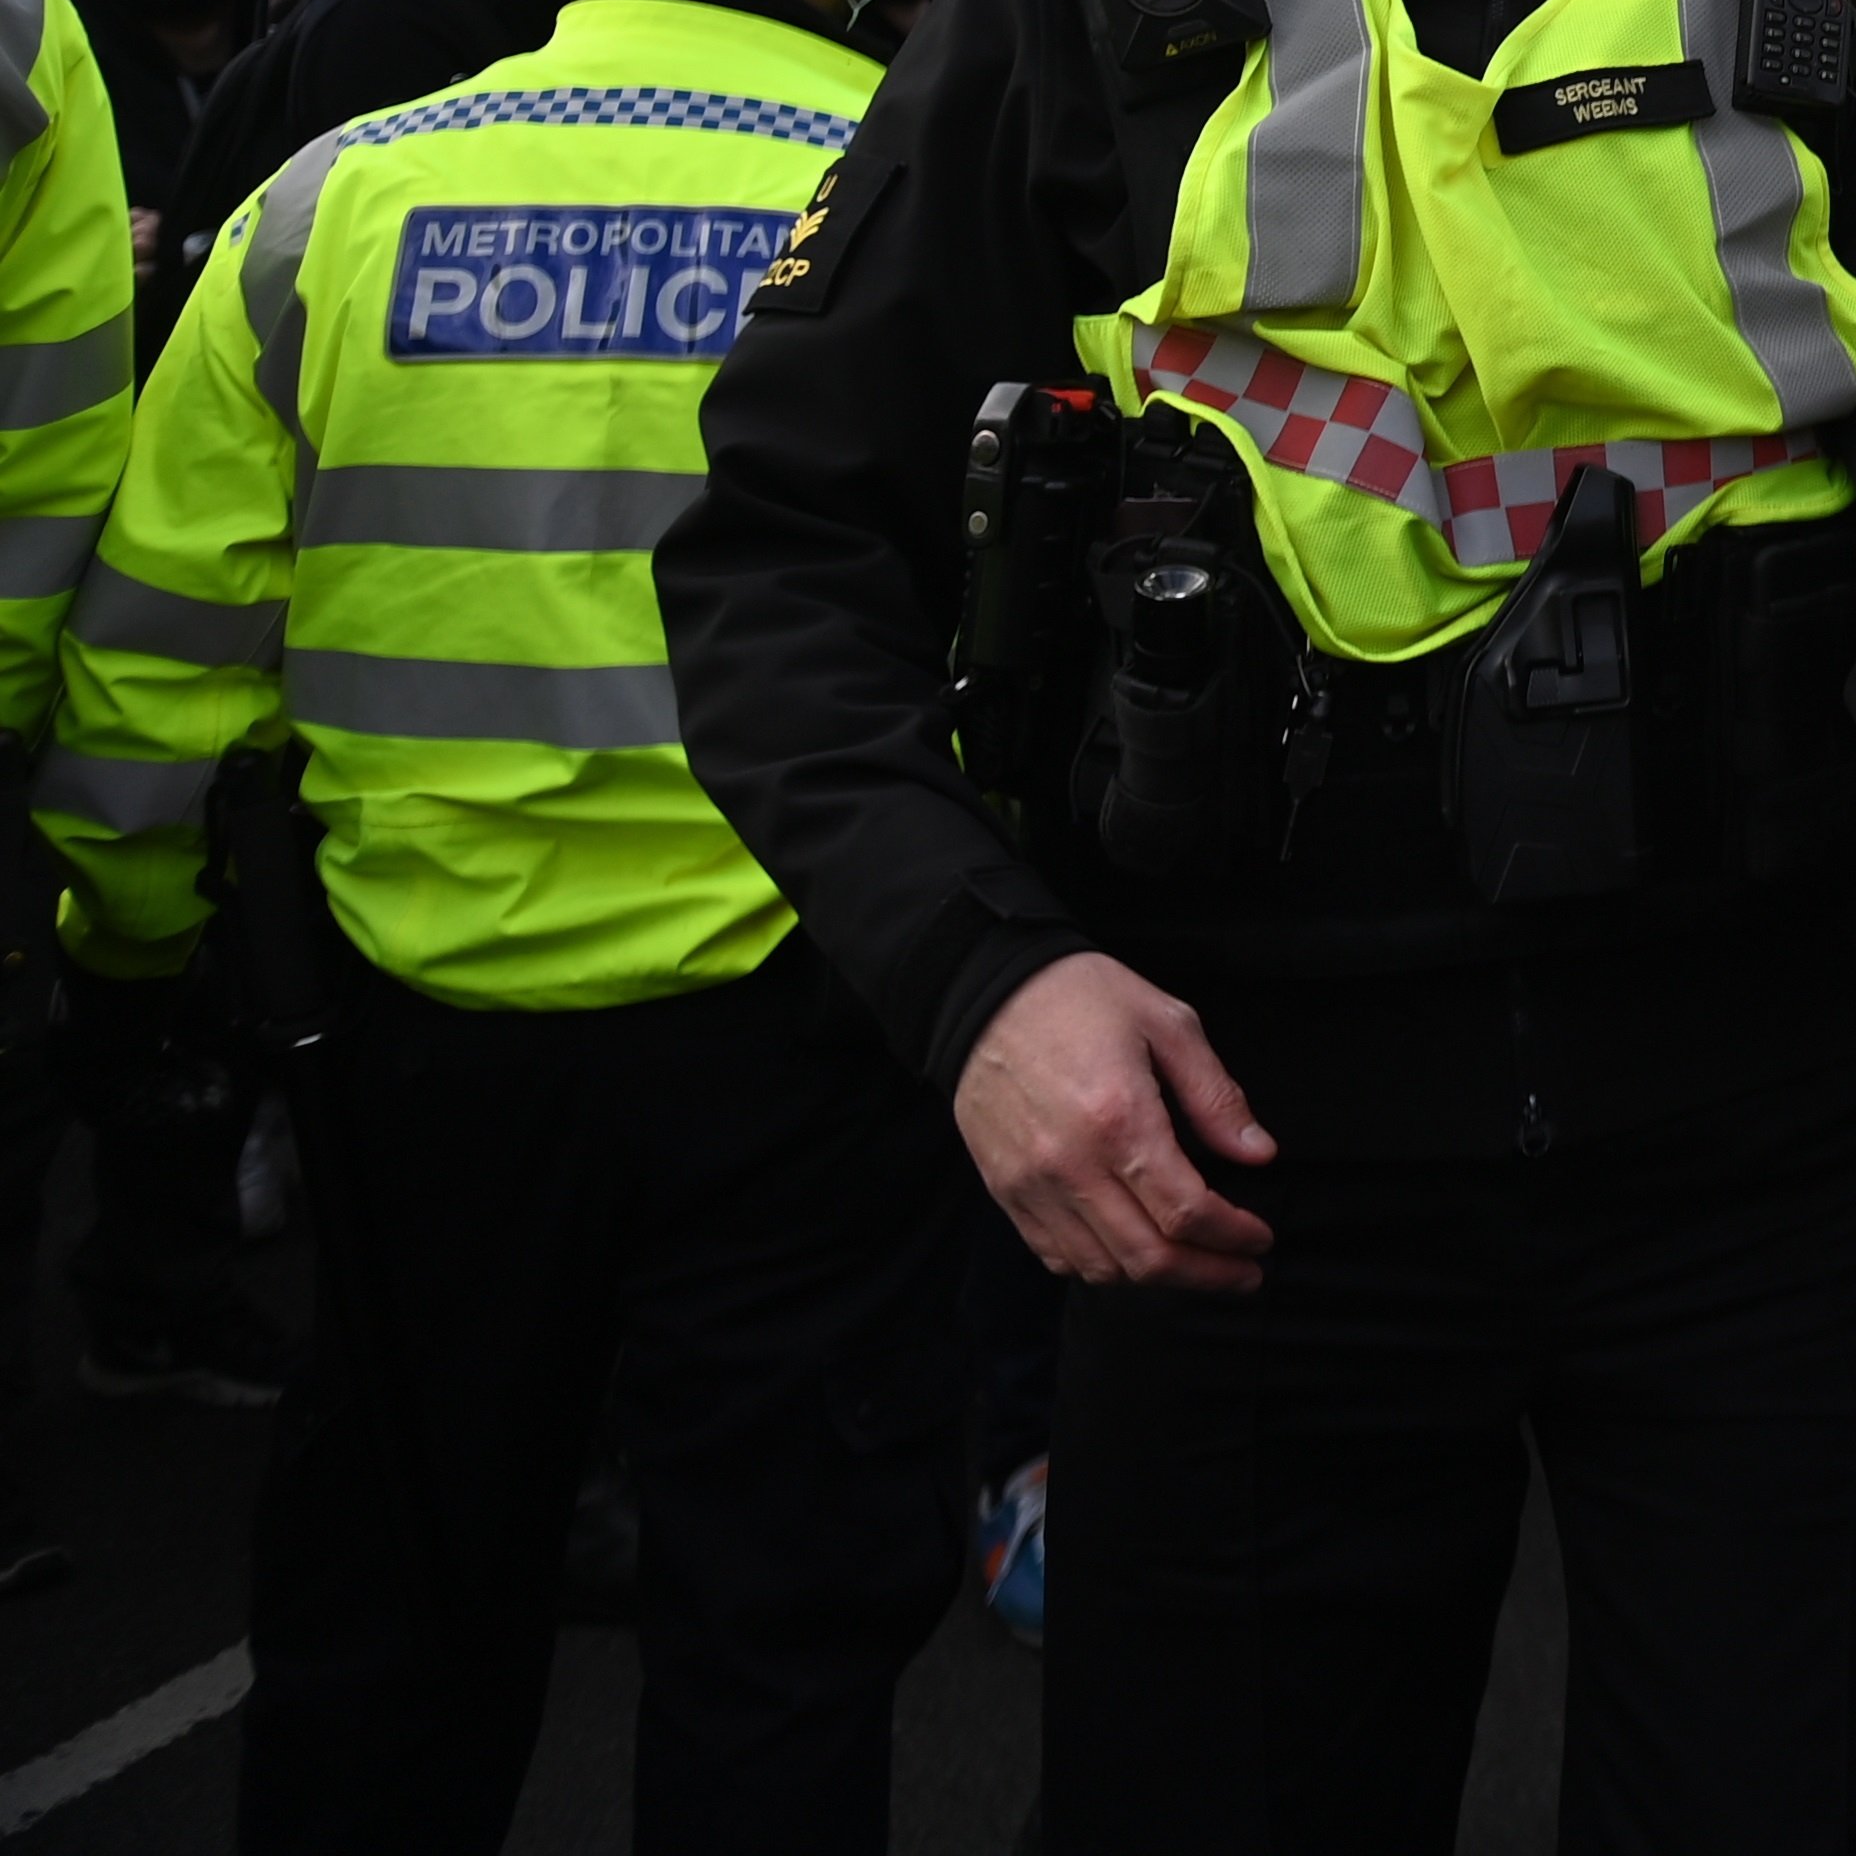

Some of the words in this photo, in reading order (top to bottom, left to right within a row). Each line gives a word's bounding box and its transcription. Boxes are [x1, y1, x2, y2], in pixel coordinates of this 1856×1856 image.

[1554, 76, 1647, 106] SERGEANT
[1572, 96, 1639, 124] WEEMS
[816, 173, 838, 203] U
